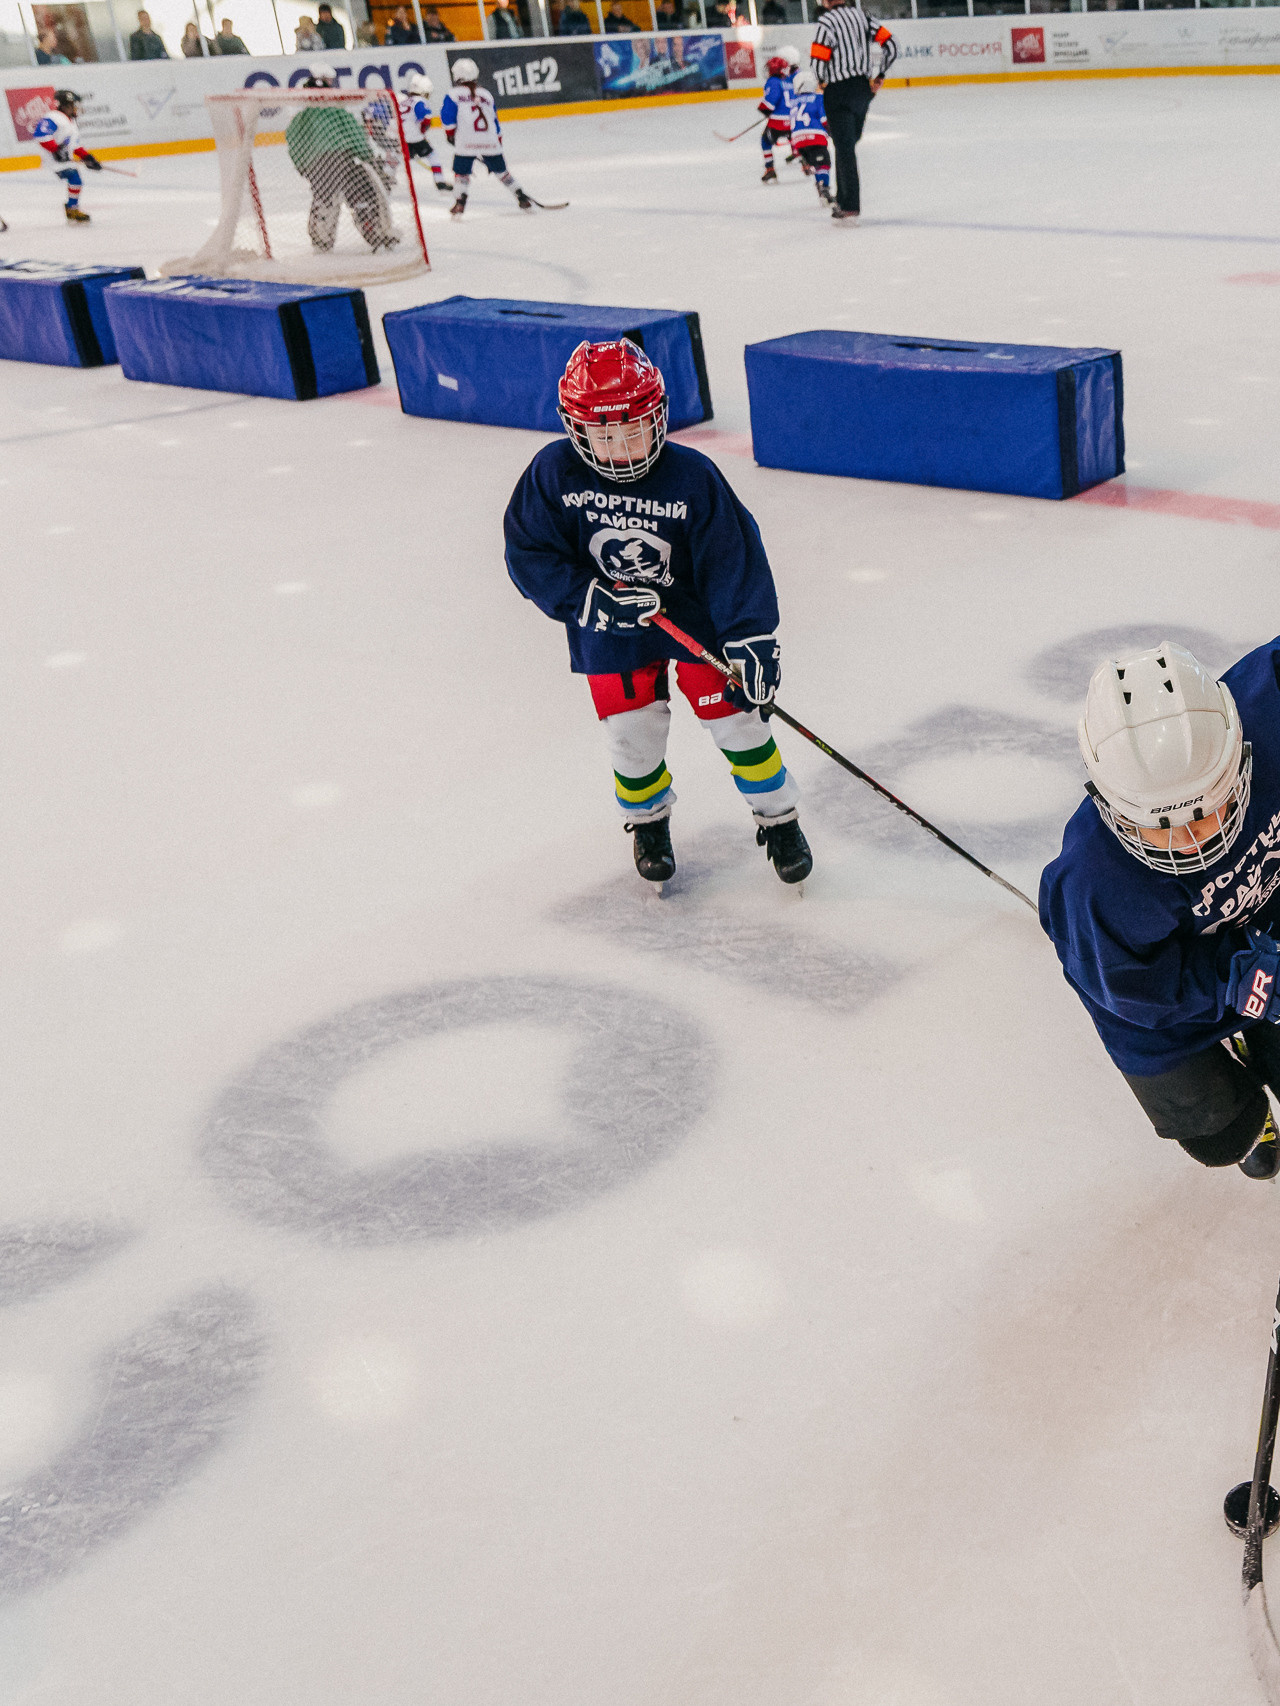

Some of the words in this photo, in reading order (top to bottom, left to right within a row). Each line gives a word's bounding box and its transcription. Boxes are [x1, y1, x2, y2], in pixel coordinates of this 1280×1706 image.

[492, 56, 562, 96] TELE2
[593, 402, 630, 413] BAUER
[562, 490, 688, 520] КУРОРТНЫЙ
[585, 511, 658, 532] РАЙОН
[1150, 795, 1204, 816] BAUER
